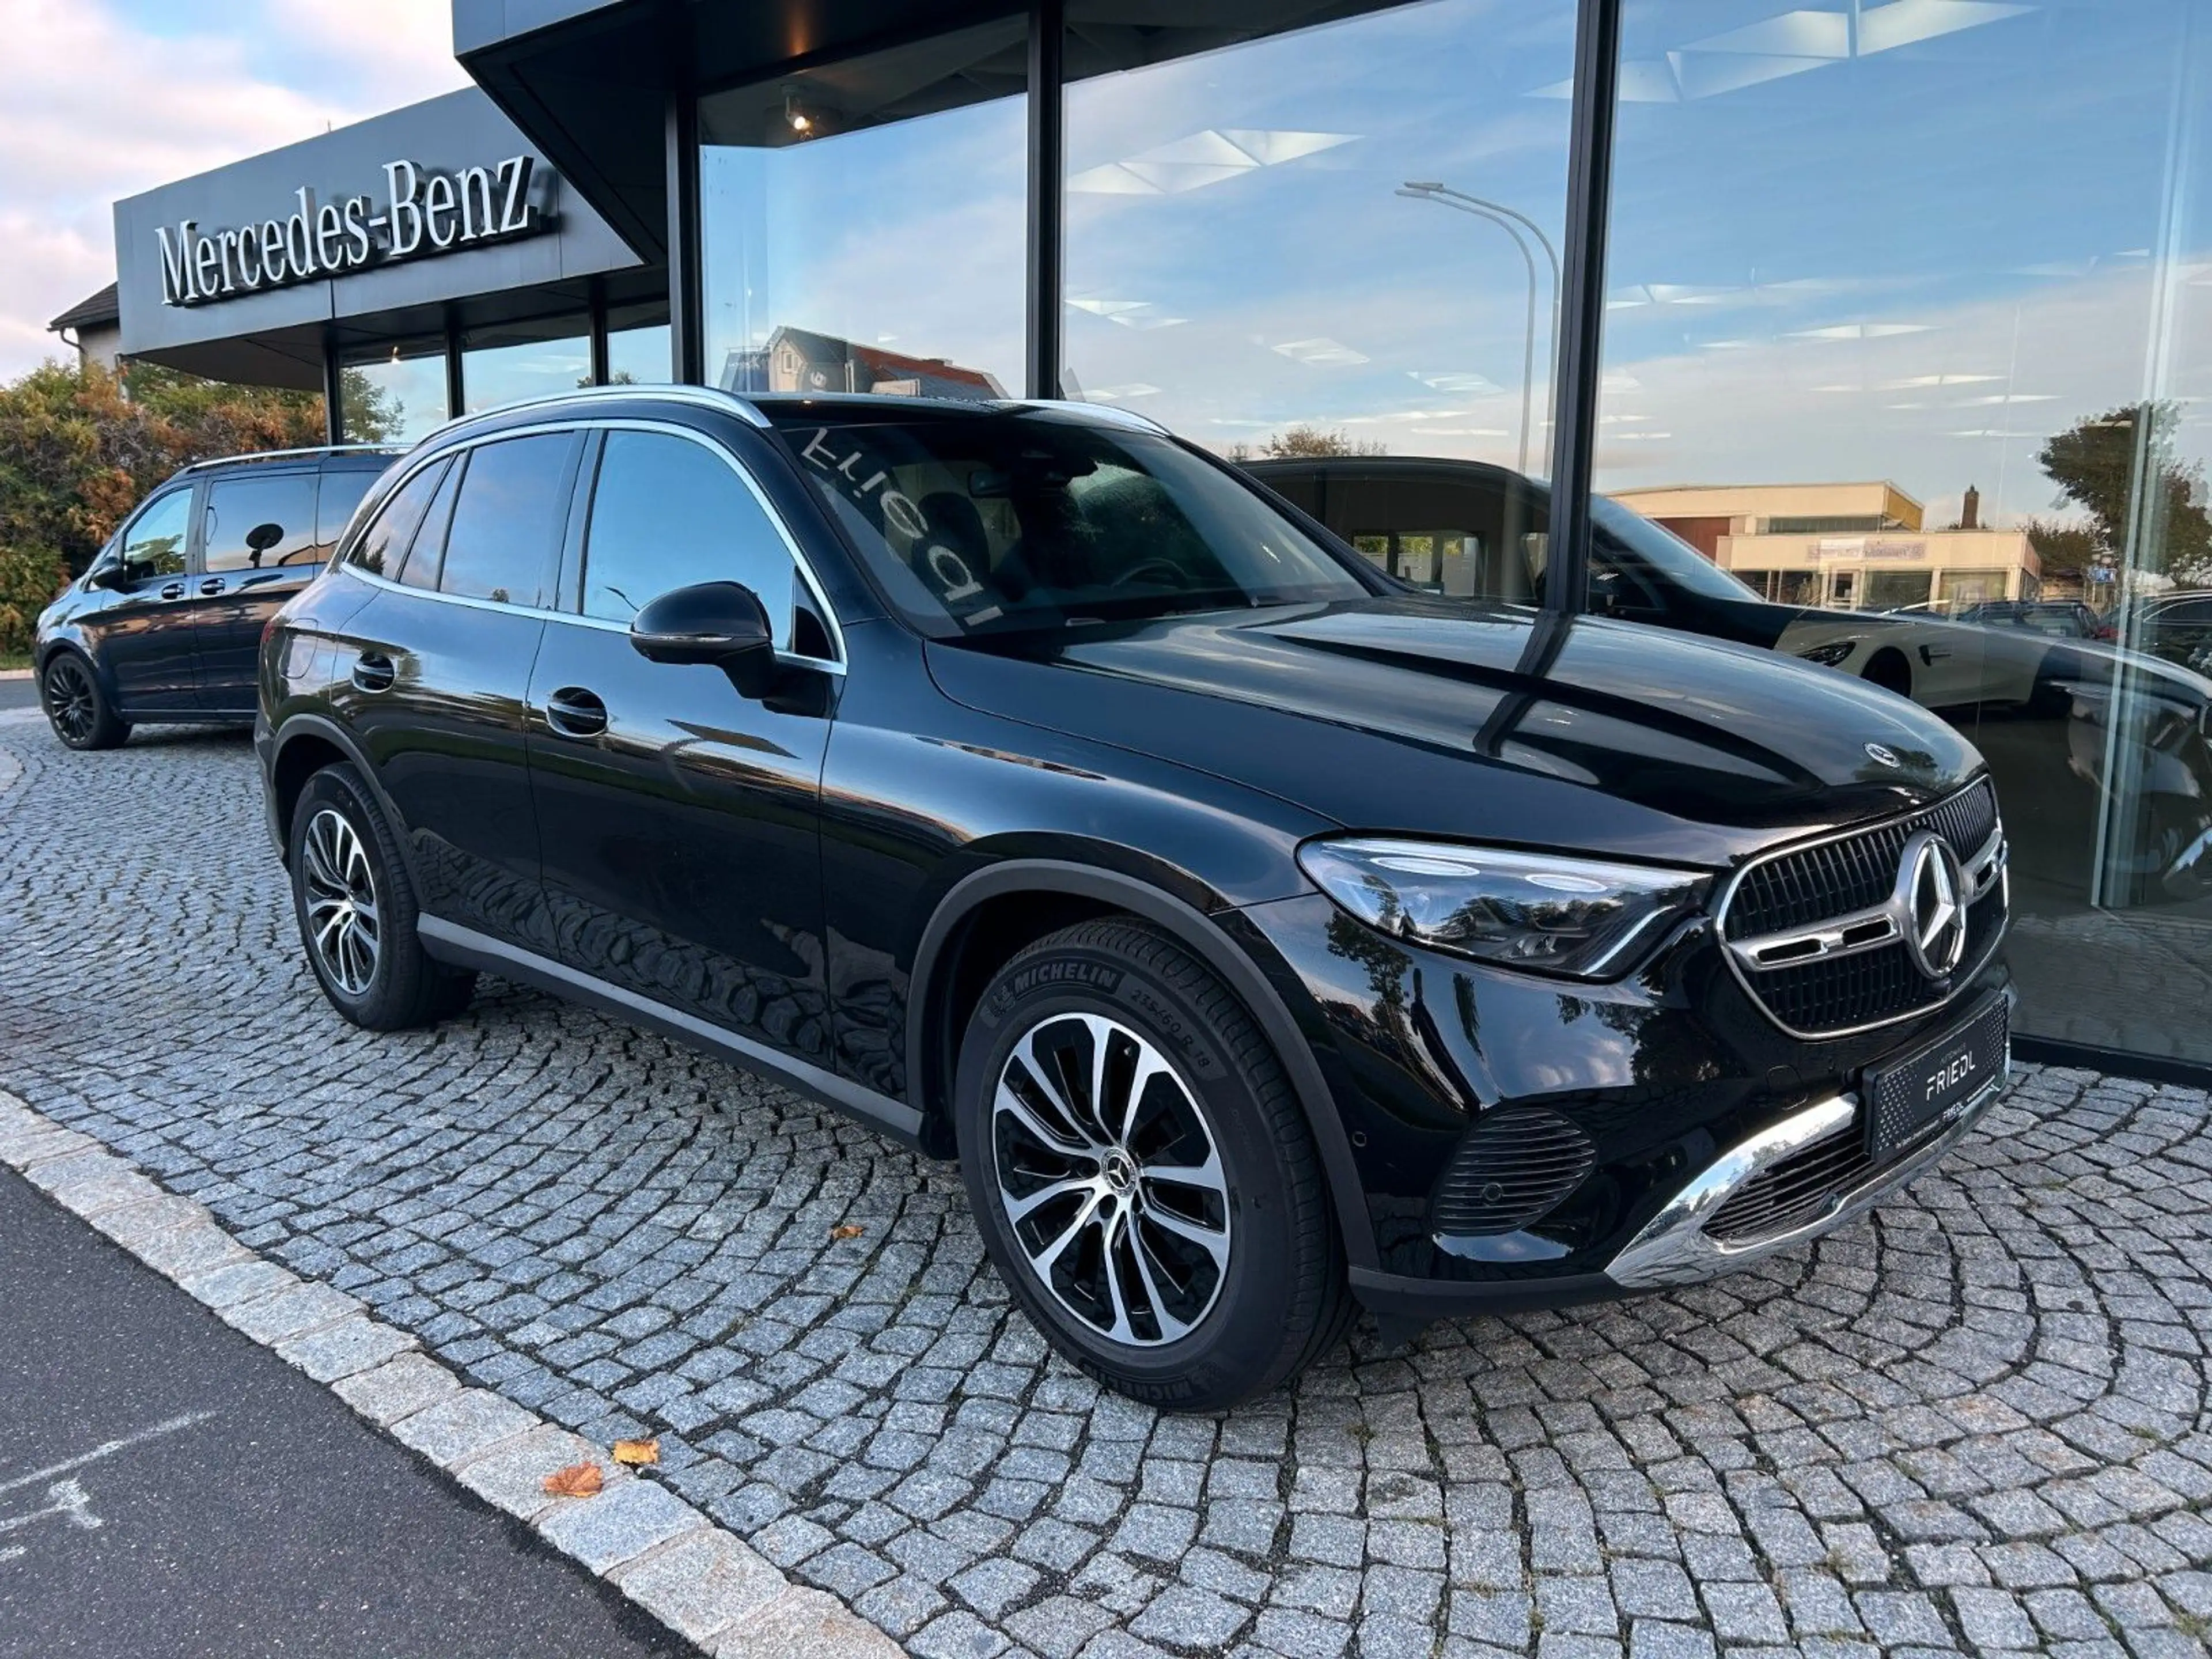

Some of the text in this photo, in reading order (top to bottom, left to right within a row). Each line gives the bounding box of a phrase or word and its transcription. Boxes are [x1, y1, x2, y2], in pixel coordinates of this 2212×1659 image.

[155, 154, 538, 305] Mercedes-Benz
[1014, 963, 1117, 993] MICHELIN
[1130, 988, 1210, 1069] 235/60 R 18
[1926, 1050, 1976, 1101] FRIEDL
